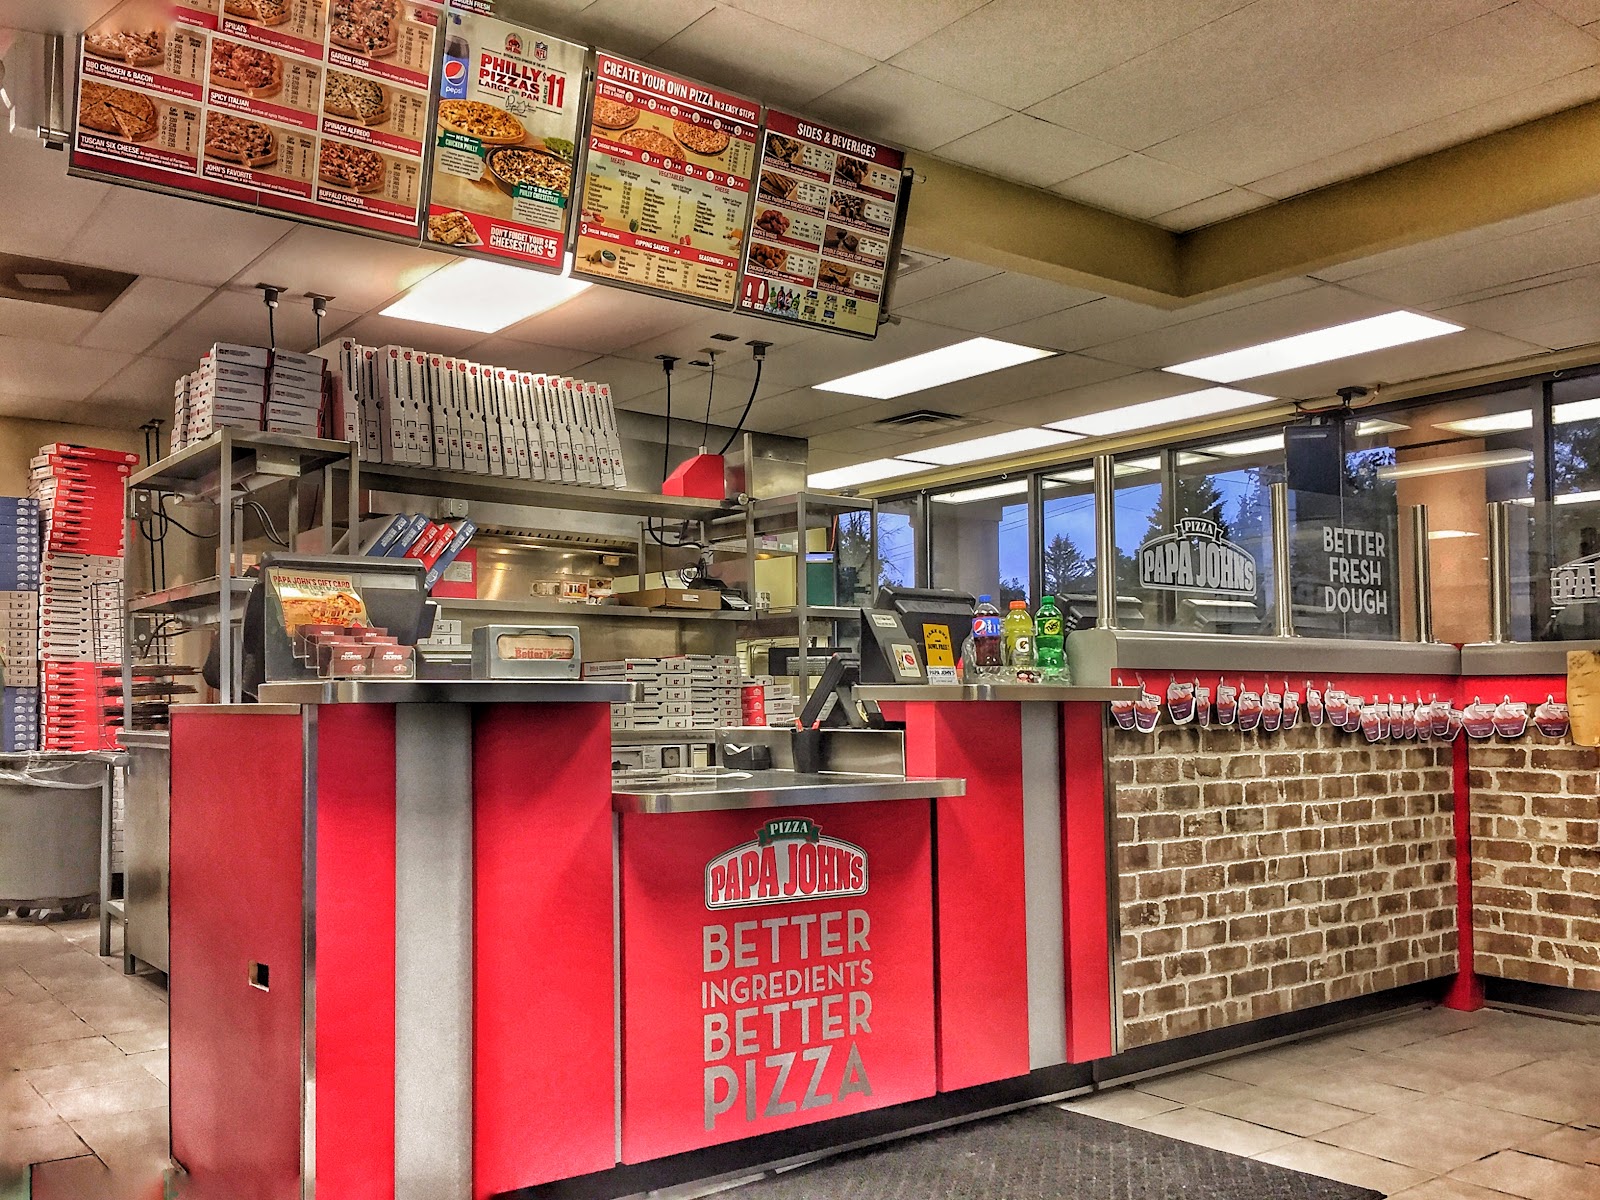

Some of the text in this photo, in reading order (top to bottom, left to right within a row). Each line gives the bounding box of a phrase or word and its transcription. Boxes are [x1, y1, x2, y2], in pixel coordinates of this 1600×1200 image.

[474, 1, 490, 10] FRESH
[331, 51, 369, 67] GARDEN FRESH
[536, 51, 546, 59] NFL
[86, 60, 99, 70] BBQ
[100, 64, 126, 76] CHICKEN
[133, 72, 154, 83] BACON
[481, 53, 542, 82] PHILLY
[479, 68, 540, 94] PIZZAS
[599, 83, 603, 94] 1
[479, 79, 510, 94] LARGE
[521, 91, 539, 102] PAN
[604, 60, 640, 84] CREATE
[642, 72, 666, 92] YOUR
[667, 81, 688, 98] OWN
[689, 88, 713, 107] PIZZA
[725, 104, 739, 115] EASY
[739, 109, 755, 120] STEPS
[211, 92, 249, 107] SPICY ITALIAN
[325, 121, 370, 137] SPINACH ALFREDO
[81, 136, 140, 154] TUSCAN SIX CHEESE
[445, 138, 478, 152] CHICKEN PHILLY
[592, 138, 597, 149] 2
[797, 123, 823, 141] SIDES
[824, 132, 830, 144] &
[832, 134, 876, 158] BEVERAGES
[611, 156, 626, 166] MEATS
[205, 164, 252, 179] JOHN'S FAVORITE
[658, 170, 684, 182] VEGETABLES
[319, 190, 364, 205] BUFFALO CHICKEN
[519, 189, 532, 197] PHILLY
[715, 186, 730, 194] CHEESE
[491, 227, 508, 238] DON'T
[509, 230, 528, 242] FORGET
[529, 235, 544, 245] YOUR
[582, 224, 587, 234] 3
[490, 234, 543, 256] CHEESESTICKS
[635, 239, 669, 252] DIPPING SAUCES
[699, 254, 724, 265] SEASONINGS
[1185, 520, 1214, 536] PIZZA
[1323, 526, 1385, 557] BETTER
[1144, 542, 1254, 591] PAPA JOHN'S
[1329, 556, 1382, 585] FRESH
[1325, 587, 1387, 615] DOUGH
[1016, 637, 1030, 652] G
[770, 821, 808, 835] PIZZA
[710, 843, 864, 903] PAPA JOHN'S
[702, 909, 871, 973] BETTER
[702, 960, 874, 1009] INGREDIENTS
[703, 991, 873, 1063] BETTER
[704, 1040, 874, 1131] PIZZA
